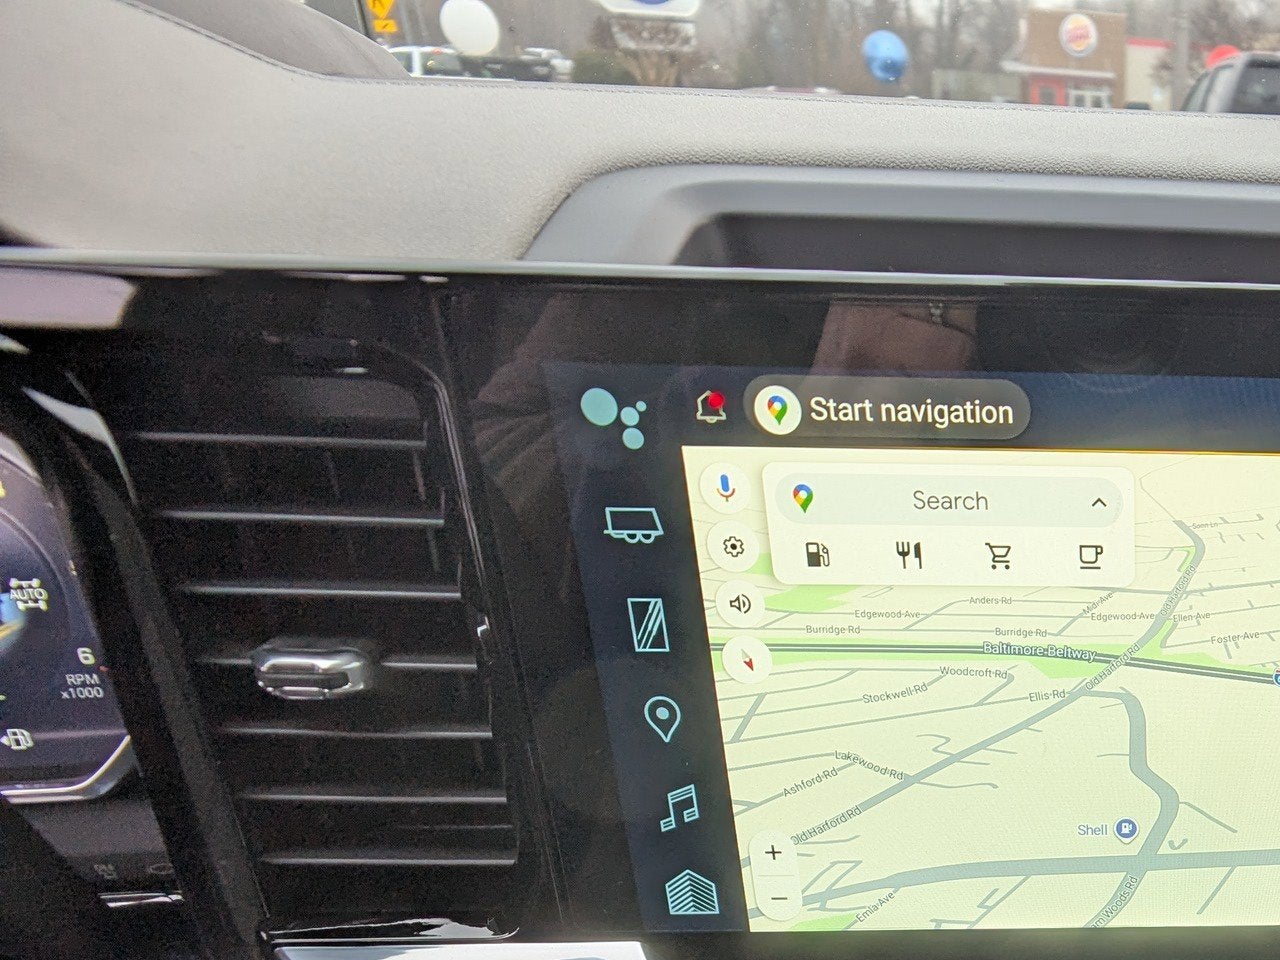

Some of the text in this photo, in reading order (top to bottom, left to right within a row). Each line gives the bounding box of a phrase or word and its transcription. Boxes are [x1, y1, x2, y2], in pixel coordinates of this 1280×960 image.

[809, 396, 1014, 429] Start navigation
[913, 490, 989, 511] Search
[10, 587, 47, 601] AUTO
[969, 596, 1012, 605] Anders Rd
[854, 609, 921, 622] Edgewood Ave
[1090, 612, 1155, 623] Edgewood Ave
[1173, 612, 1211, 623] Ellen Ave
[805, 624, 861, 636] Burridge Rd
[994, 628, 1047, 639] Burridge Rd
[1210, 631, 1260, 644] Foster Ave
[76, 647, 96, 666] 6
[983, 641, 1097, 663] Baltimore Beltway
[940, 666, 1008, 680] Woodcroft Rd
[1085, 643, 1140, 691] Old Harford Rd
[65, 673, 102, 686] RPM
[60, 686, 105, 699] x1000
[862, 681, 928, 704] Stockwell Rd
[1029, 689, 1066, 702] Ellis Rd
[834, 750, 904, 781] Lakewood Rd
[783, 767, 839, 797] Ashford Rd
[807, 814, 847, 838] Harford
[846, 805, 863, 820] Rd
[1077, 824, 1108, 836] Shell
[878, 891, 895, 907] Ave
[1101, 889, 1130, 918] Woods
[1124, 875, 1138, 891] Rd
